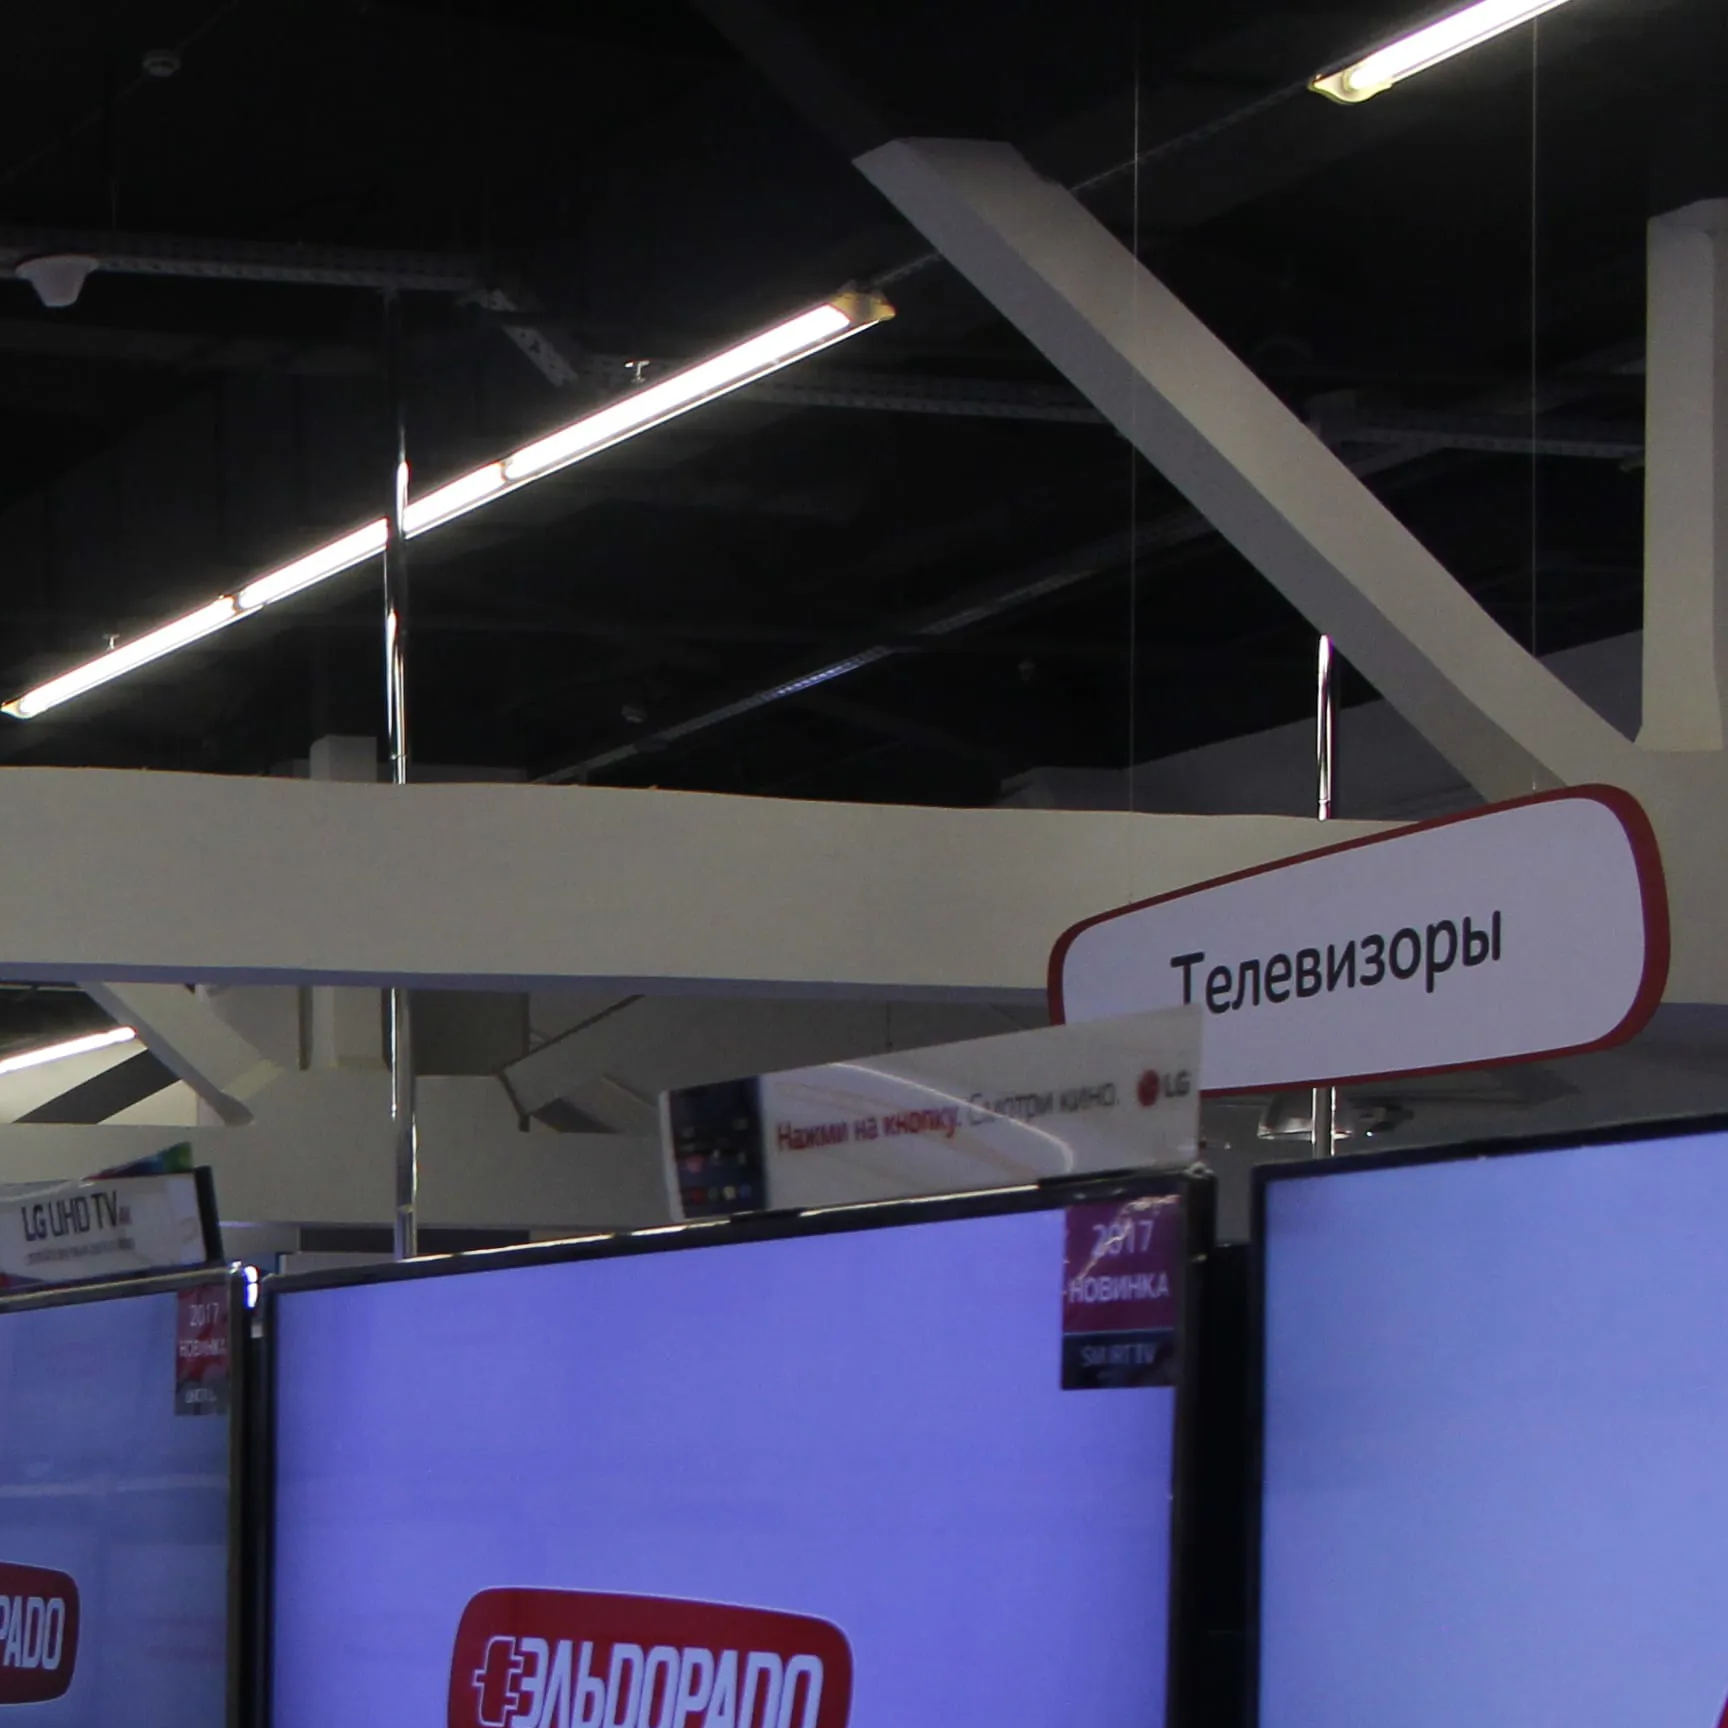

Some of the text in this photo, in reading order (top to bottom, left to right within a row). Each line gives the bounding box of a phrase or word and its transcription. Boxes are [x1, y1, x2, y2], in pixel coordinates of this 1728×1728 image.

[1170, 908, 1503, 1014] Телевизоры
[1162, 1069, 1192, 1097] LG
[776, 1120, 849, 1152] Нажми
[855, 1118, 878, 1141] на
[20, 1204, 47, 1242] LG
[48, 1195, 91, 1236] UHD
[91, 1190, 118, 1228] TV
[1090, 1218, 1155, 1256] 2017
[1068, 1271, 1170, 1304] НОВИНКА
[189, 1303, 220, 1328] 2017
